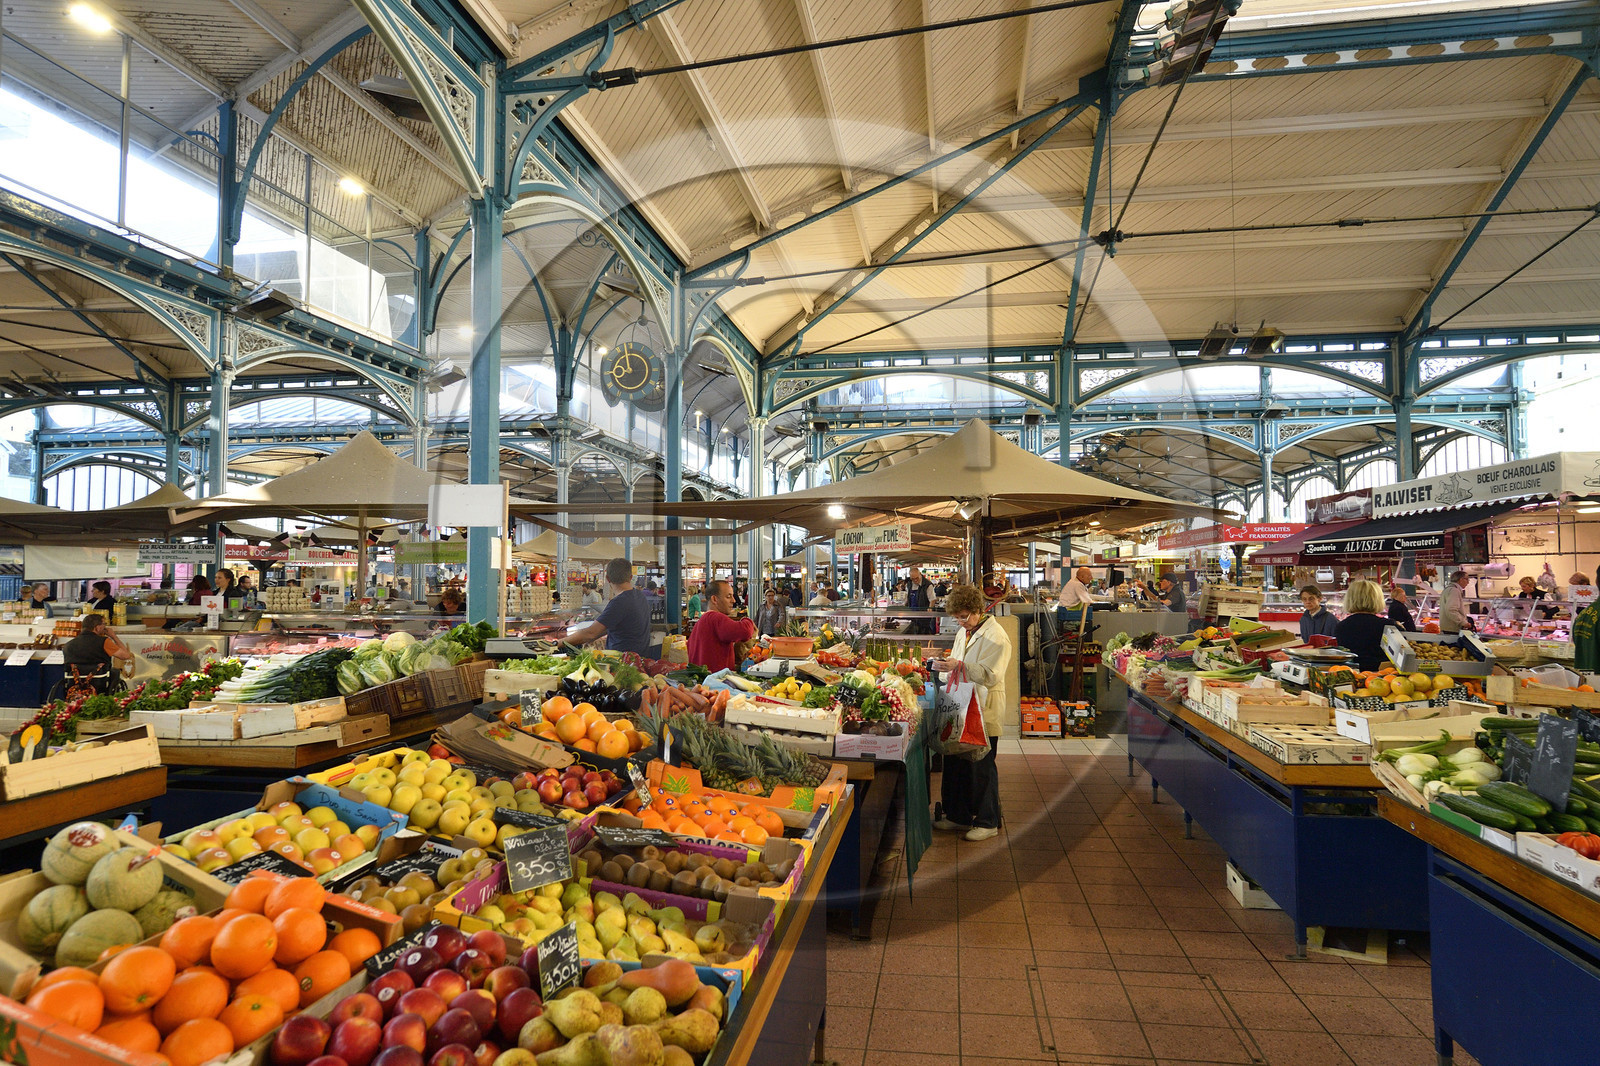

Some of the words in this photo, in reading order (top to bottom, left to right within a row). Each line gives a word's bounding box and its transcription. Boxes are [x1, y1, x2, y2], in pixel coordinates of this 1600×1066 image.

[1502, 460, 1556, 479] CHAROLLAIS
[1490, 482, 1508, 494] VENTE
[1509, 477, 1541, 492] EXCLUSIVE
[1374, 484, 1433, 508] R.ALVISET
[1306, 543, 1337, 554] Boucherie
[1343, 539, 1385, 553] ALVISET
[1393, 536, 1440, 550] Charcuterie
[318, 791, 339, 809] Duo
